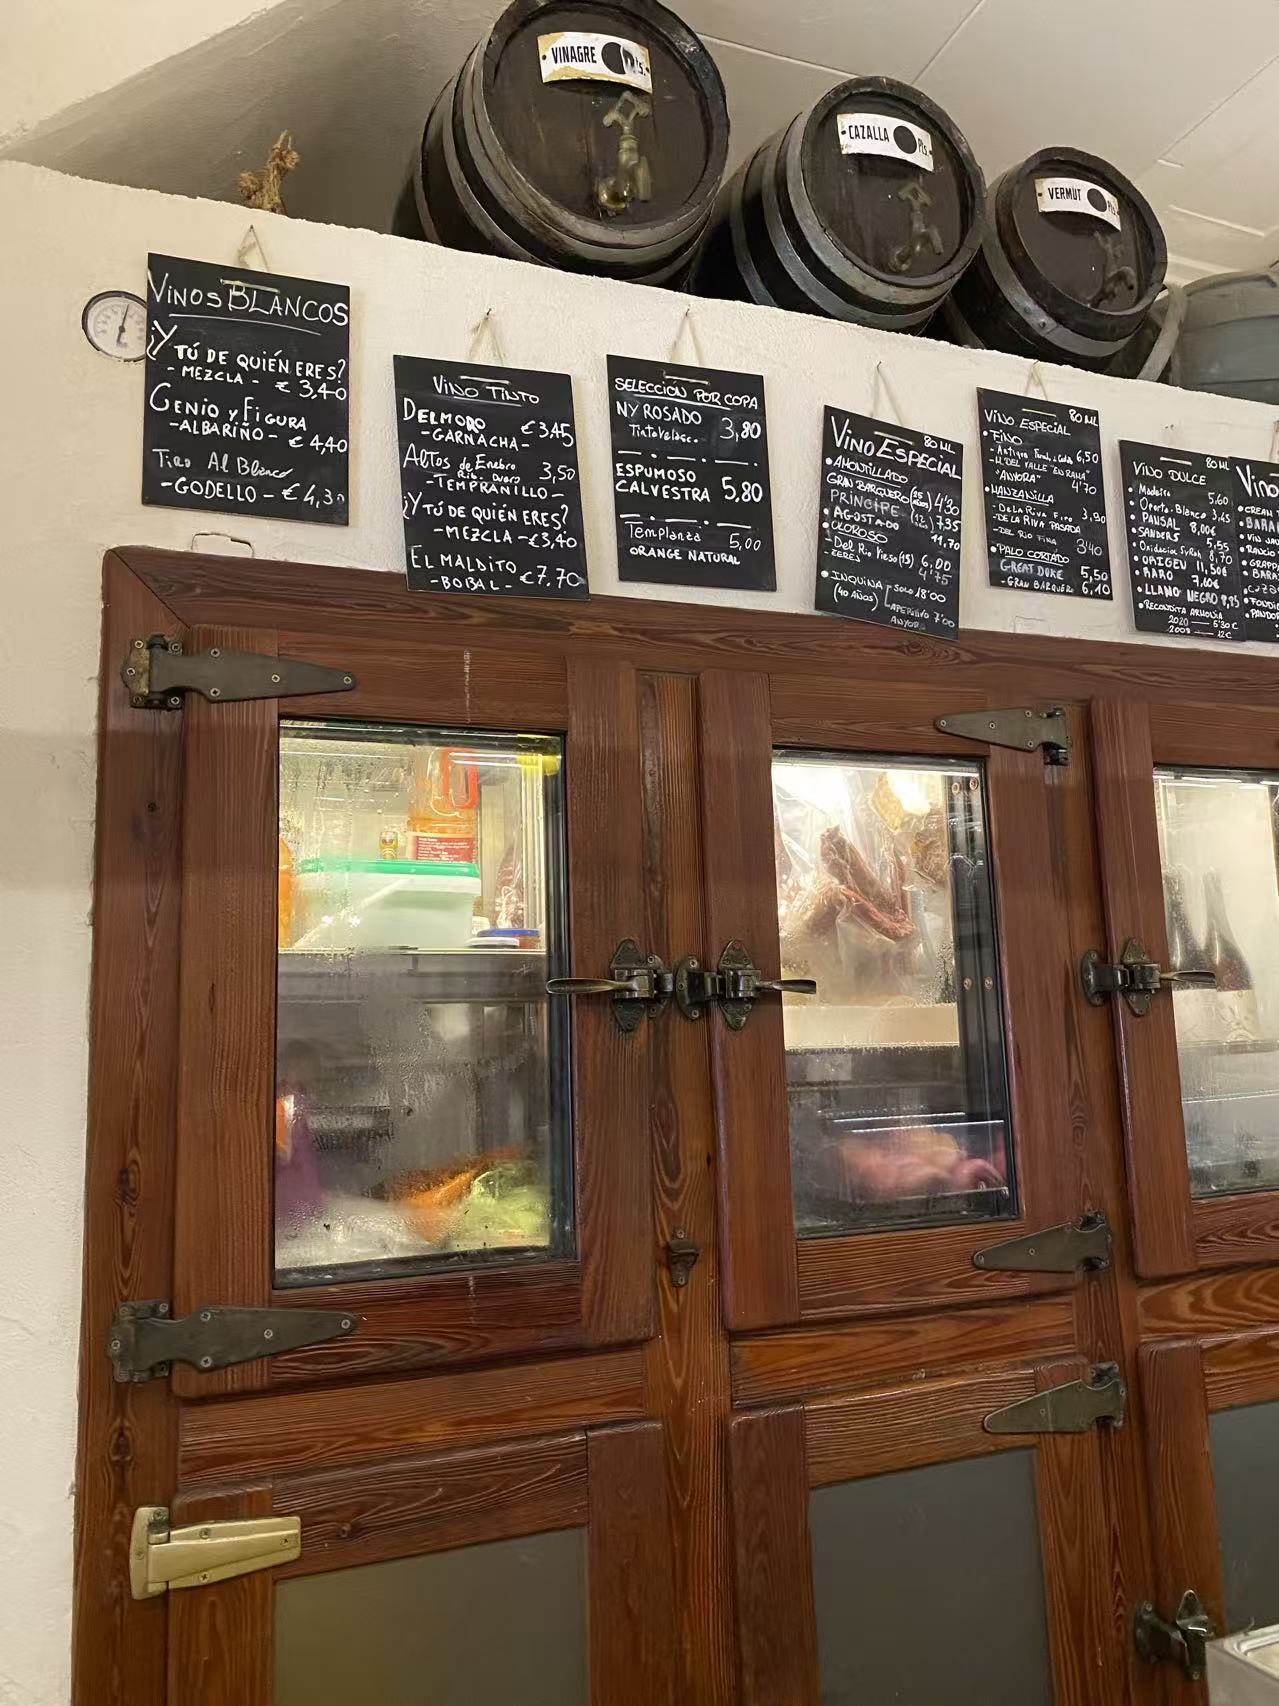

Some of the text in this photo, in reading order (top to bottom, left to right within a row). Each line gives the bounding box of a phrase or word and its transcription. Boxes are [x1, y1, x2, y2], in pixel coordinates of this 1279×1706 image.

[551, 46, 597, 64] VINAGRE
[848, 125, 890, 142] CAZALLA
[1047, 186, 1081, 201] VERMUT
[228, 284, 348, 326] BLANCOS
[207, 348, 229, 365] DE
[236, 350, 290, 374] QUIÉN
[296, 358, 346, 384] ERES?
[299, 379, 347, 401] 3,40
[433, 375, 540, 404] VINO TINTO
[693, 389, 721, 406] POR
[724, 394, 759, 410] COPA
[615, 401, 762, 443] NY ROSADO 3,80
[1019, 418, 1072, 436] ESPECIAL
[309, 434, 348, 455] 4,40
[207, 451, 229, 473] Al
[459, 457, 474, 473] de
[475, 454, 516, 471] Enebro
[539, 461, 576, 484] 3,50
[876, 438, 963, 480] ESPECIAL
[615, 463, 697, 483] ESPUMOSO
[826, 472, 854, 488] GRAN
[1168, 469, 1207, 486] DULCE
[615, 476, 764, 503] CALVESTRA 5,80
[830, 488, 901, 517] PRINCIPE
[447, 505, 467, 518] DE
[471, 502, 518, 524] QUIÉN
[522, 504, 570, 535] ERES?
[1142, 511, 1181, 531] PANSAL
[729, 533, 762, 551] 5,00
[831, 520, 888, 544] OLOROSO
[1138, 526, 1181, 542] SANDERS
[411, 544, 517, 574] EL MALDITO
[629, 545, 742, 566] ORANGE NATURAL
[997, 543, 1070, 564] PALO CORTADO
[1000, 558, 1109, 583] GREAT DUKE 5,50
[1081, 581, 1111, 596] 6,10
[1144, 583, 1180, 598] LLANO
[1186, 589, 1218, 605] NEGRO
